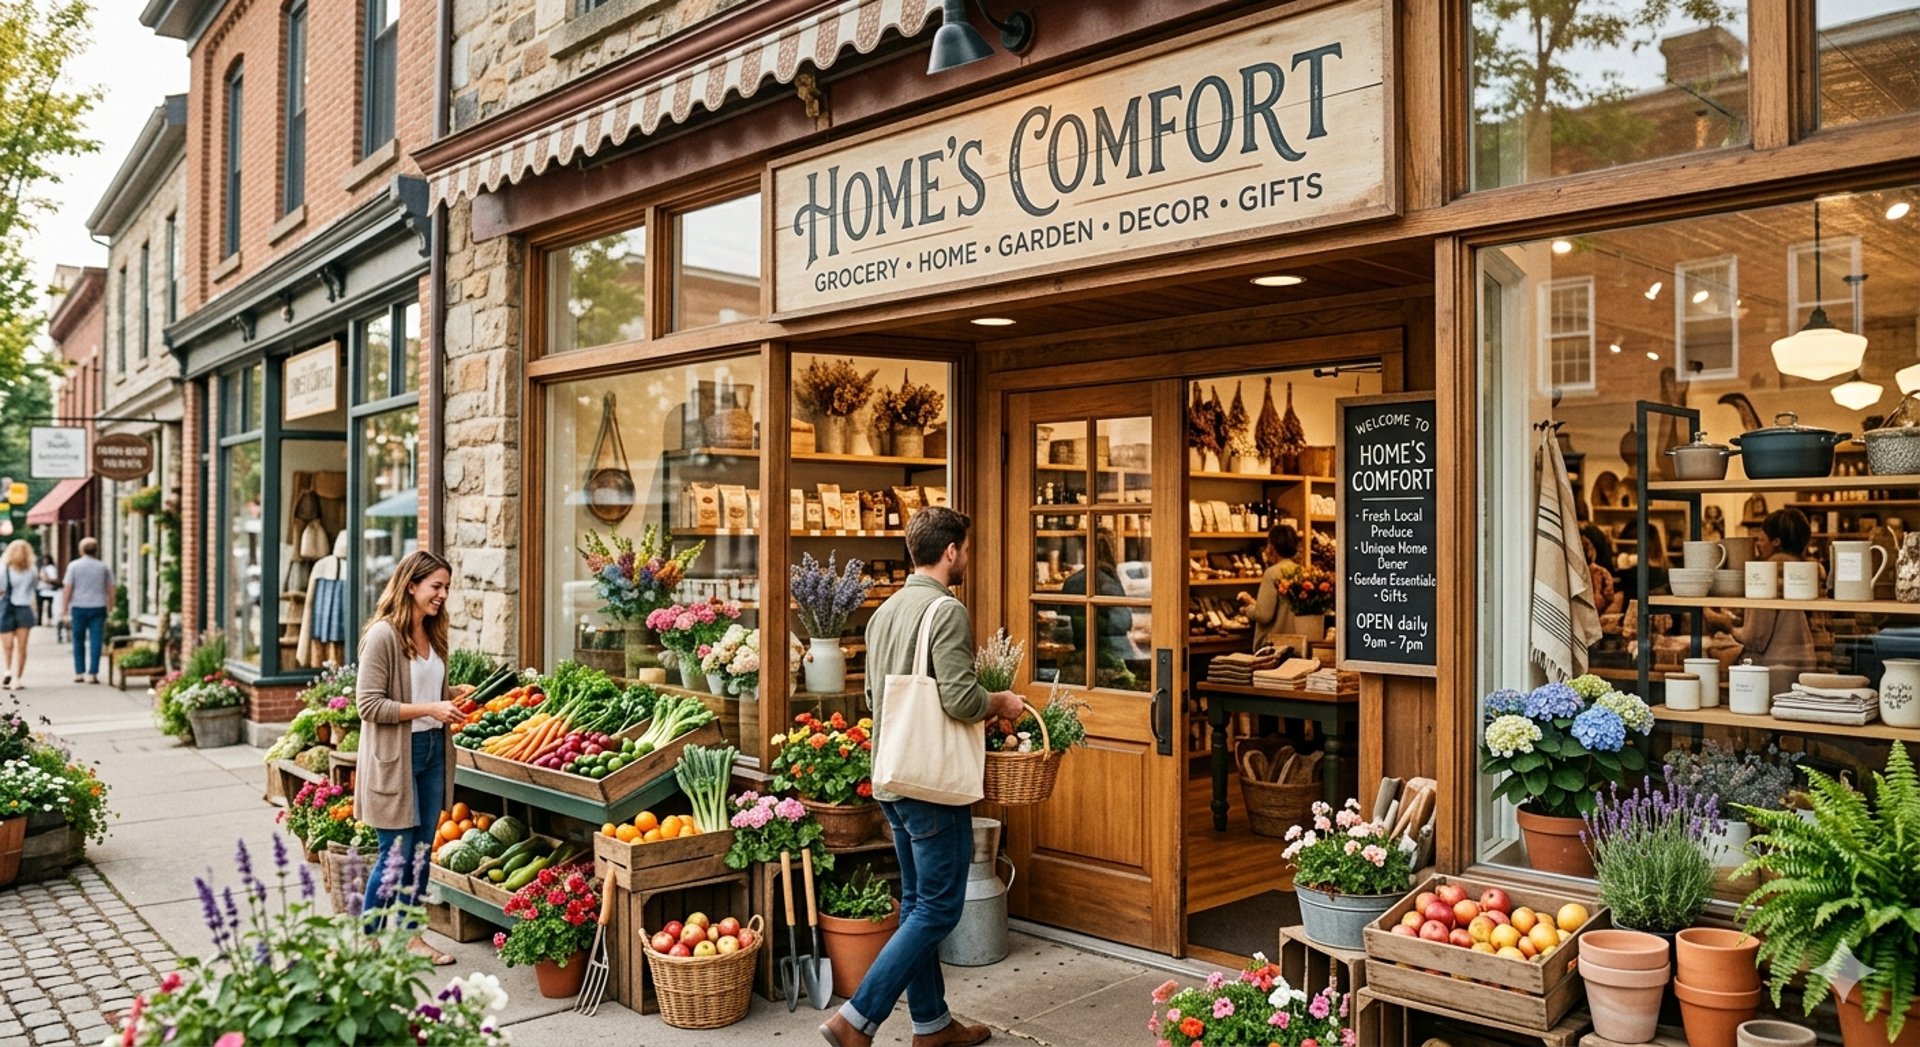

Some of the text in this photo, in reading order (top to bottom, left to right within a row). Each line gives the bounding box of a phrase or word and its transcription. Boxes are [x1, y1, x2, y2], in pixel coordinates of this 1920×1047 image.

[794, 42, 1342, 270] HOME'S COMFORT
[815, 172, 1323, 292] GROCERY HOME GARDEN DECOR GIFTS
[1355, 414, 1430, 435] WELCOME TO
[1360, 440, 1426, 466] HOME'S
[1352, 468, 1434, 492] COMFORT
[1362, 507, 1423, 522] Fresh Local
[1380, 588, 1408, 603] Gifts
[1356, 612, 1428, 637] OPEN daily
[1398, 635, 1423, 654] 7pm
